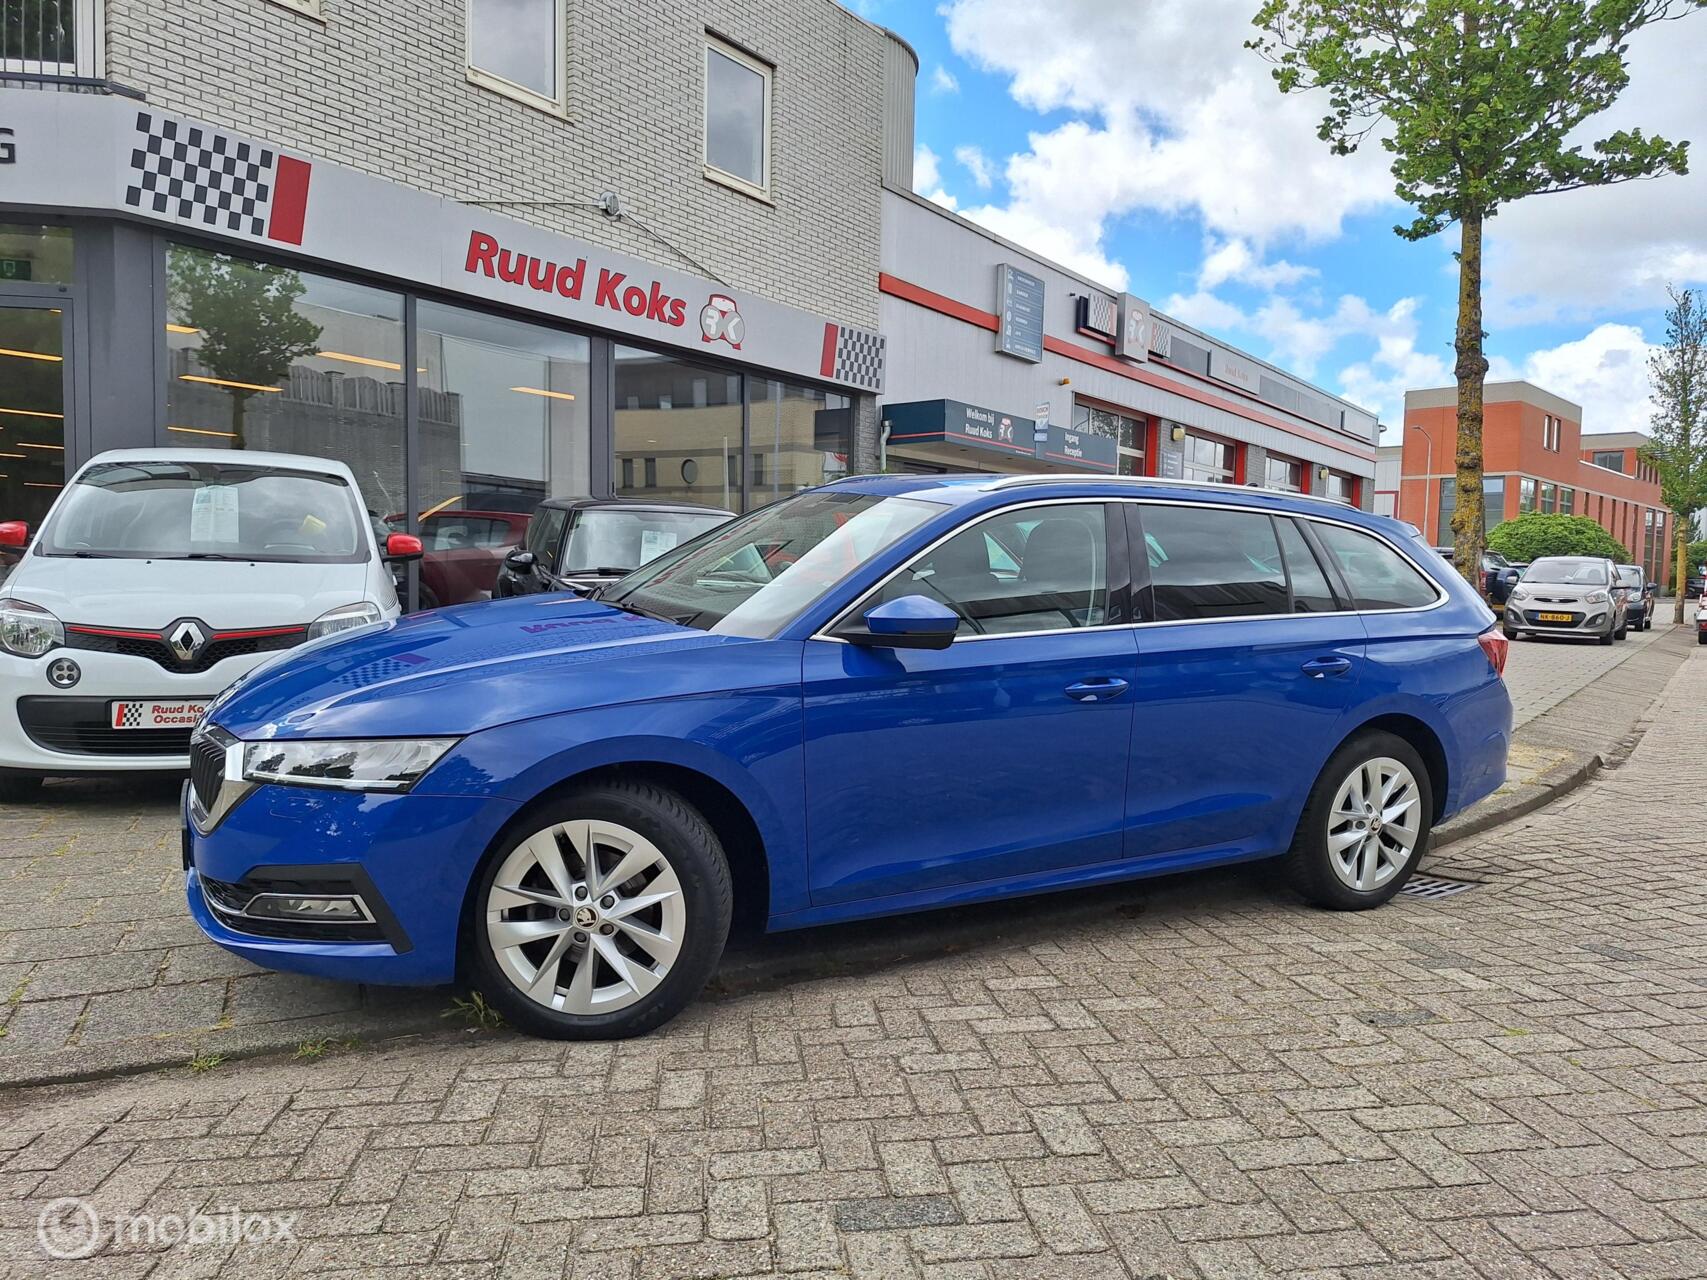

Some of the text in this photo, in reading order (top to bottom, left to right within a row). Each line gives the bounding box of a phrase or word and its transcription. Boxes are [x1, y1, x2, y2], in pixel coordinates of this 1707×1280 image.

[465, 230, 687, 327] Ruud Koks
[966, 407, 988, 422] Welkom
[965, 423, 980, 436] Ruud
[980, 426, 993, 439] Koks
[152, 704, 204, 714] Ruud Ko
[154, 715, 199, 723] Occasi
